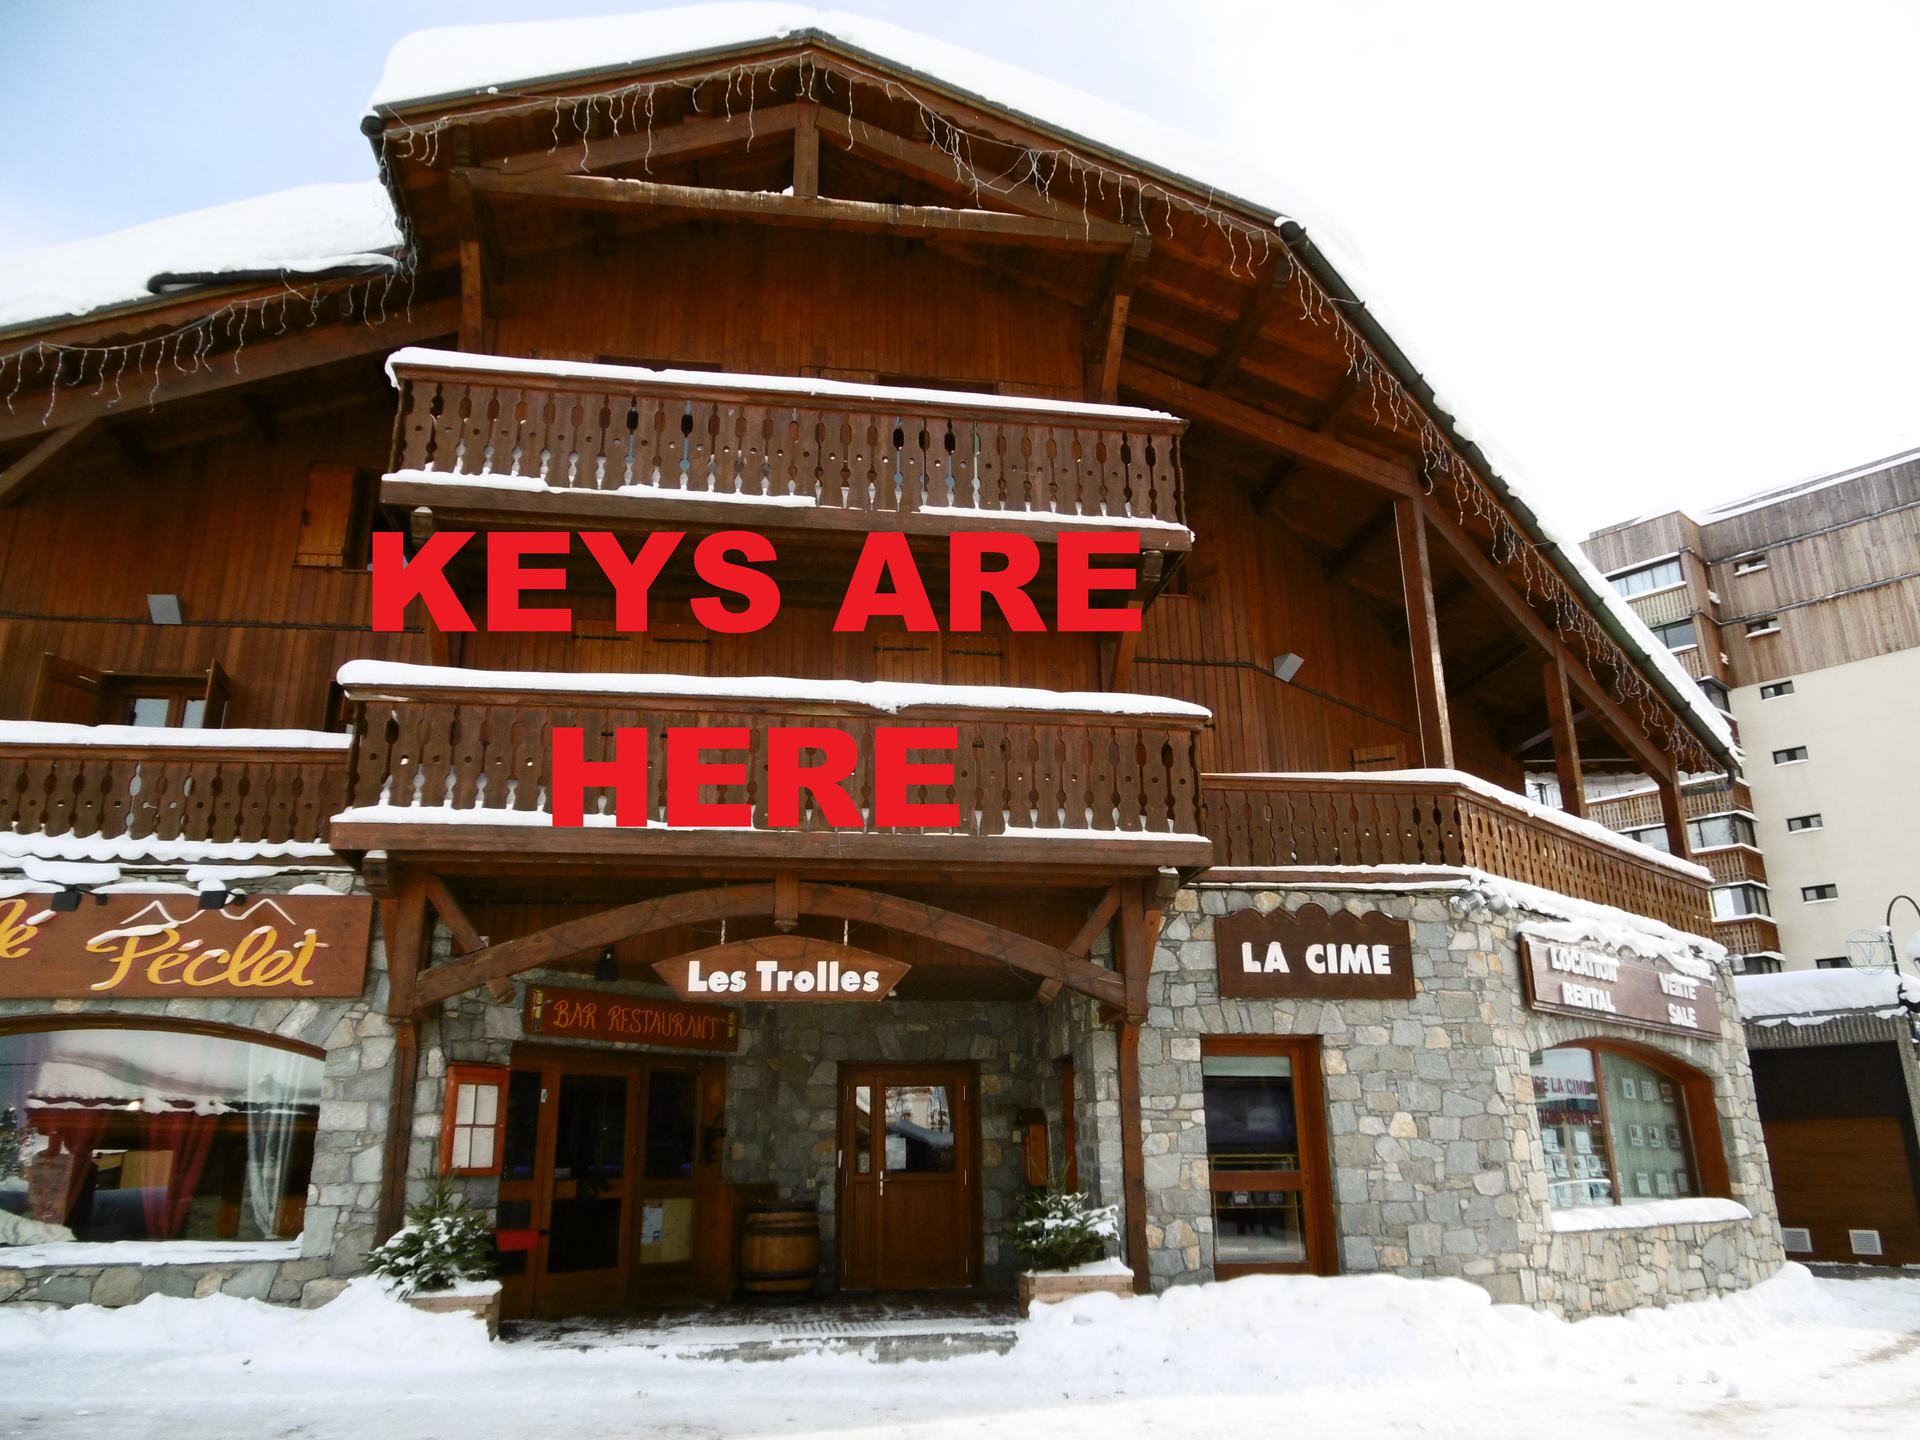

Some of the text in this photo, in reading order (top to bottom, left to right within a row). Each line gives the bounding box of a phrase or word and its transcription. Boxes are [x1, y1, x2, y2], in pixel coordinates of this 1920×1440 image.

[85, 924, 329, 991] Péclet
[1241, 941, 1393, 976] LA CIME
[1549, 945, 1620, 983] LOCATION
[687, 960, 880, 992] Les Trolles
[1658, 971, 1698, 1000] VENTE
[1561, 981, 1616, 1014] RENTAL
[552, 999, 597, 1030] BAR
[607, 1004, 722, 1041] RESTAURANT
[1667, 1002, 1697, 1028] SALE
[1550, 1077, 1565, 1094] LA
